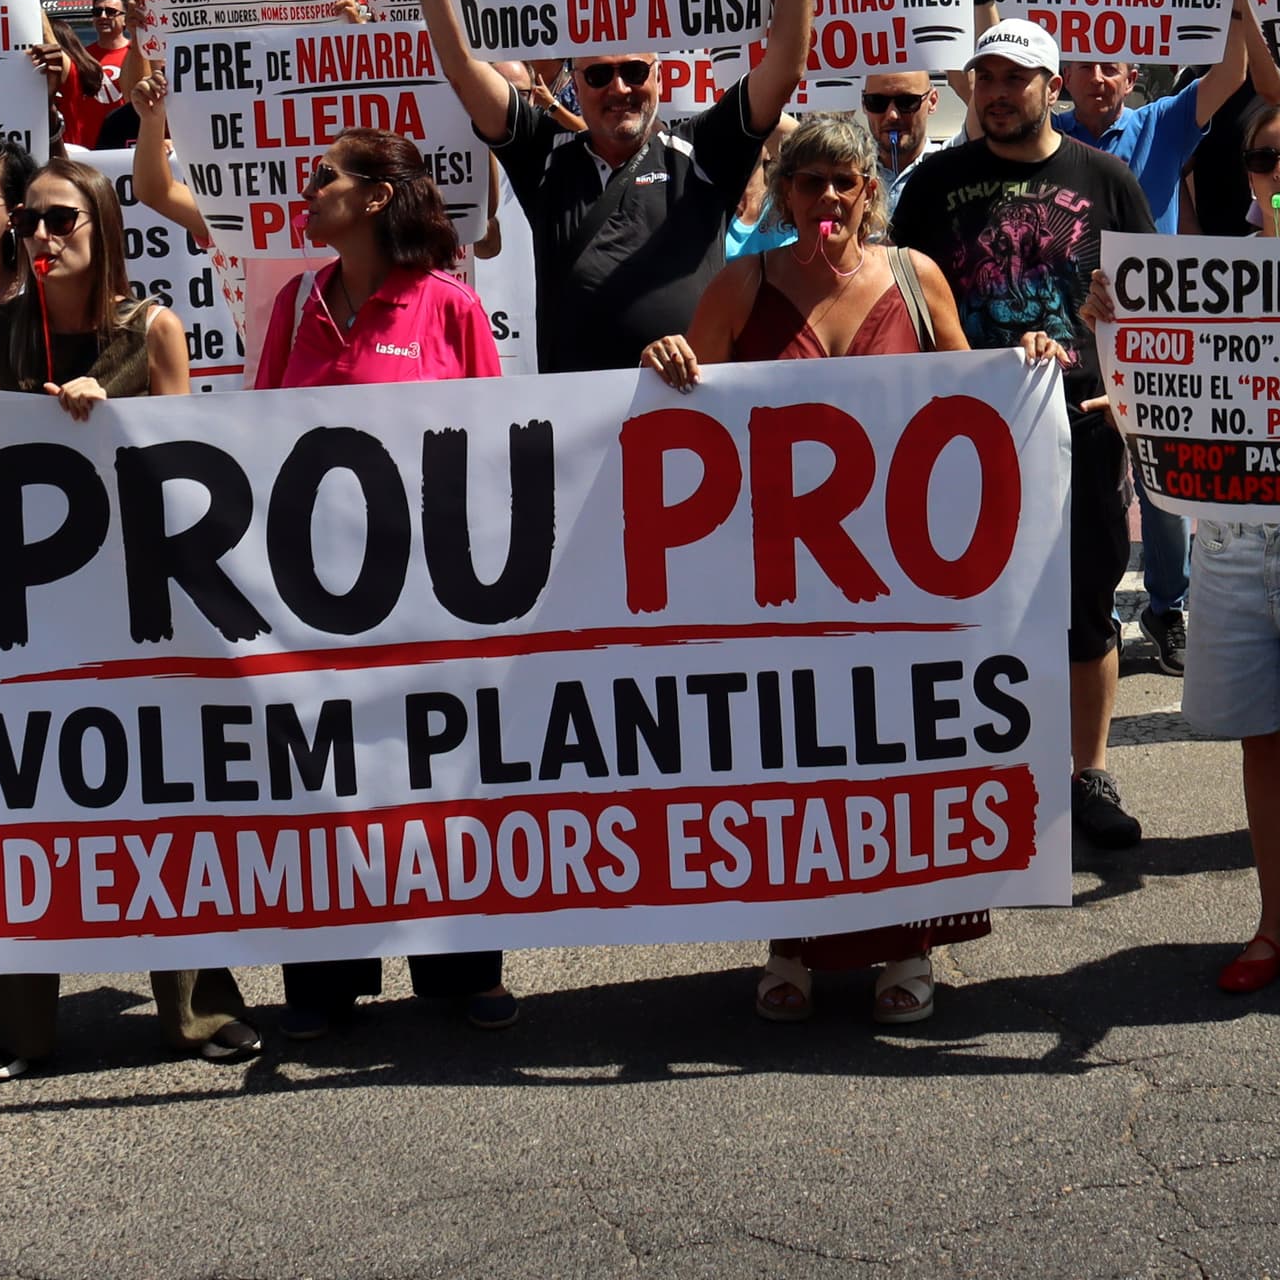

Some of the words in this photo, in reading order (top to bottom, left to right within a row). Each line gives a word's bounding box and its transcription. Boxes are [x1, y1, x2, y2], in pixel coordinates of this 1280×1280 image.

[173, 41, 262, 94] PERE,
[266, 51, 291, 80] DE
[296, 31, 435, 84] NAVARRA
[1126, 331, 1186, 362] PROU
[1134, 372, 1202, 400] DEIXEU
[1211, 374, 1232, 400] EL
[619, 395, 1021, 615] PRO
[406, 654, 1031, 790] PLANTILLES
[1, 804, 640, 924] D'EXAMINADORS
[668, 779, 1009, 891] ESTABLES
